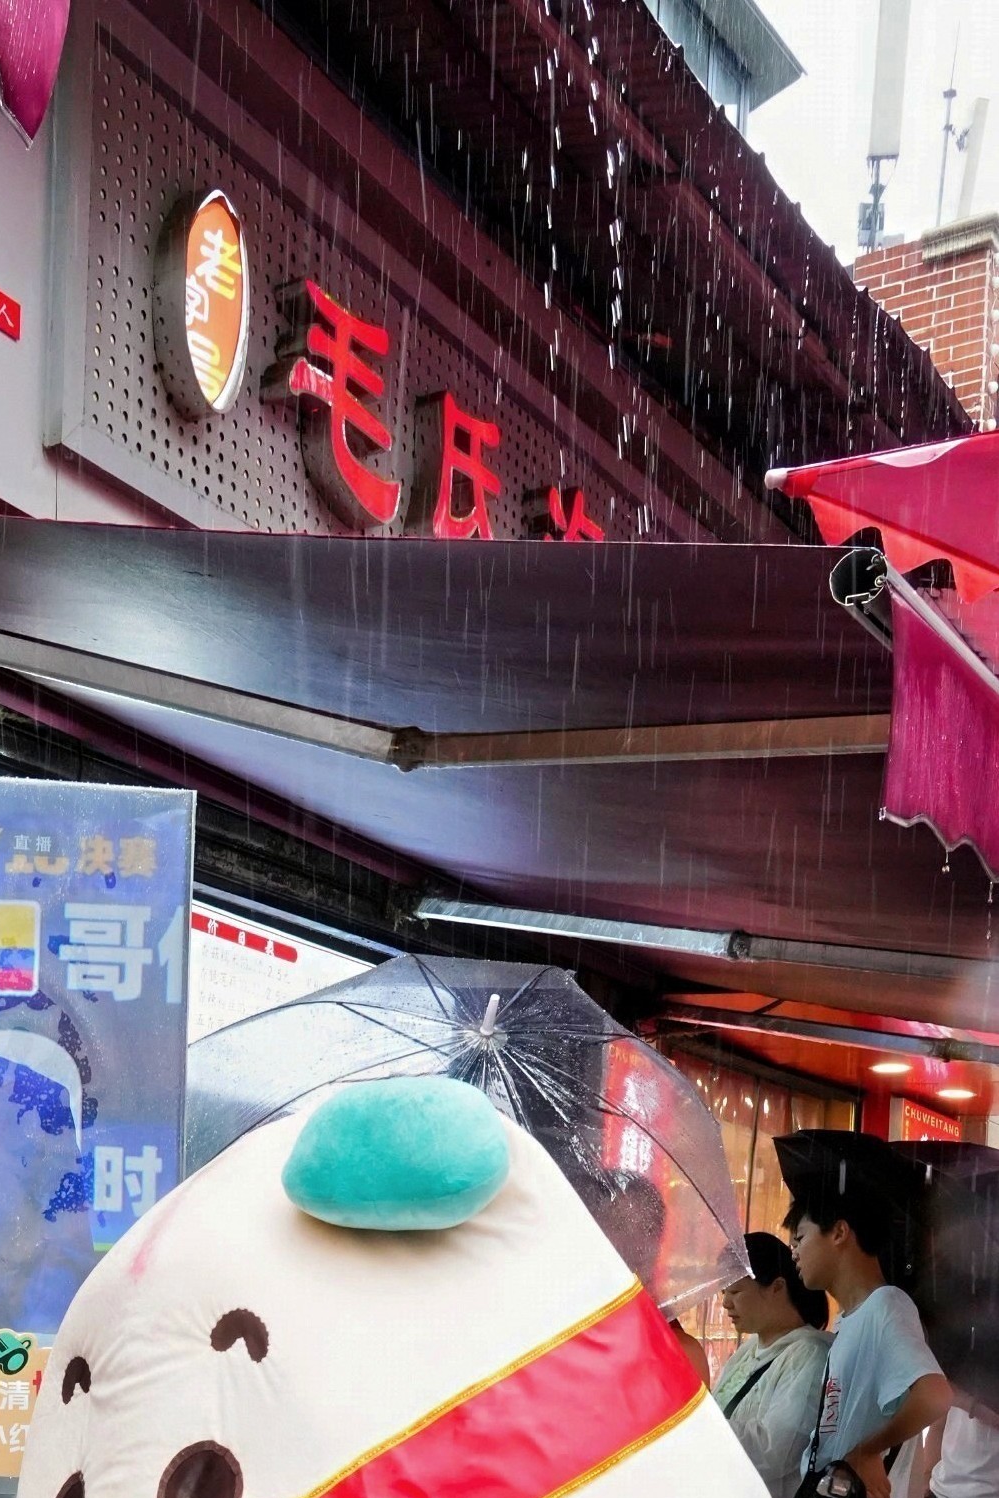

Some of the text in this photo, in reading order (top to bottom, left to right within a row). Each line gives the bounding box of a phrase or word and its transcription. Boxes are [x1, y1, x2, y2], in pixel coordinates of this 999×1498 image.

[14, 835, 52, 852] 直播
[904, 1105, 960, 1137] CHUWEITANG
[93, 1144, 163, 1217] 时
